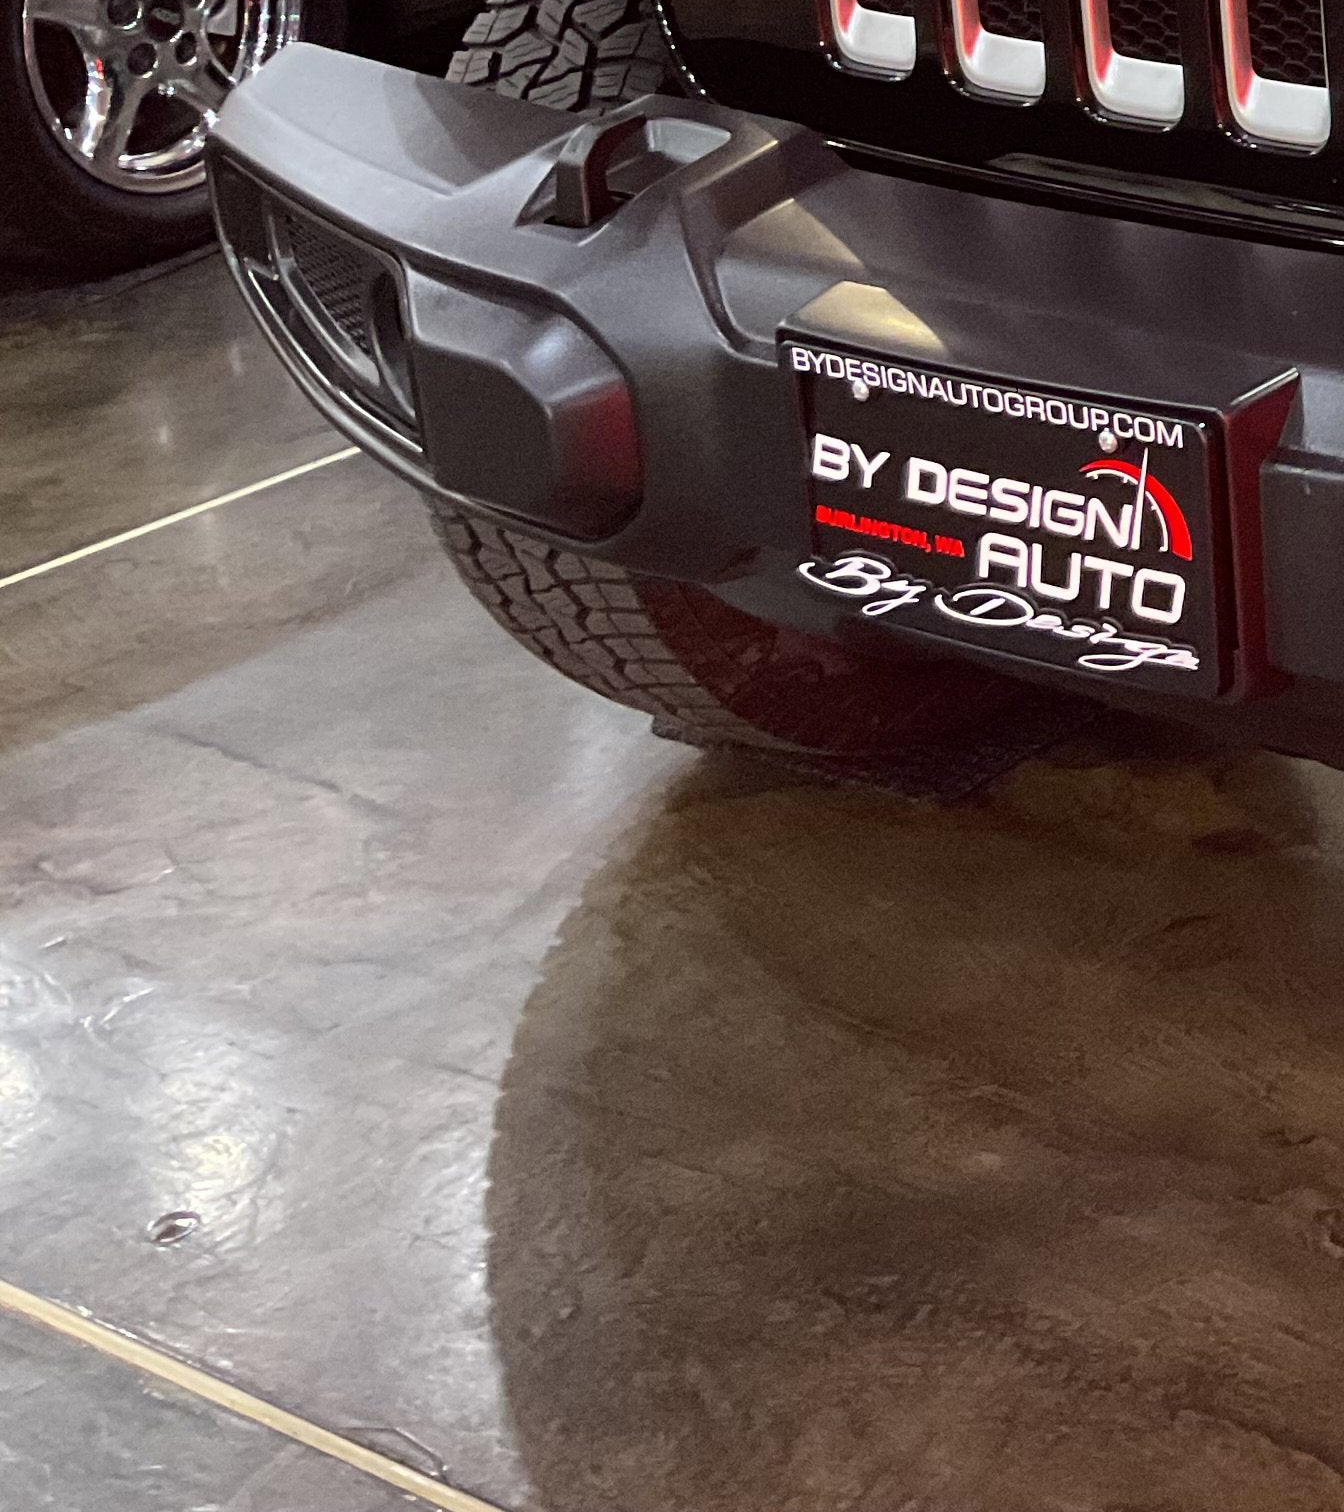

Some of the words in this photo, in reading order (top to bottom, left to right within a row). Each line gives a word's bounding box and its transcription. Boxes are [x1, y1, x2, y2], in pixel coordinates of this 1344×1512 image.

[791, 346, 1184, 449] BYDESIGNAUTOGROUP.COM
[811, 432, 890, 489] BY
[905, 456, 1135, 550] DESIGN
[934, 534, 966, 559] WA
[977, 532, 1187, 626] AUTO
[798, 556, 927, 616] By
[934, 587, 1200, 672] Design
